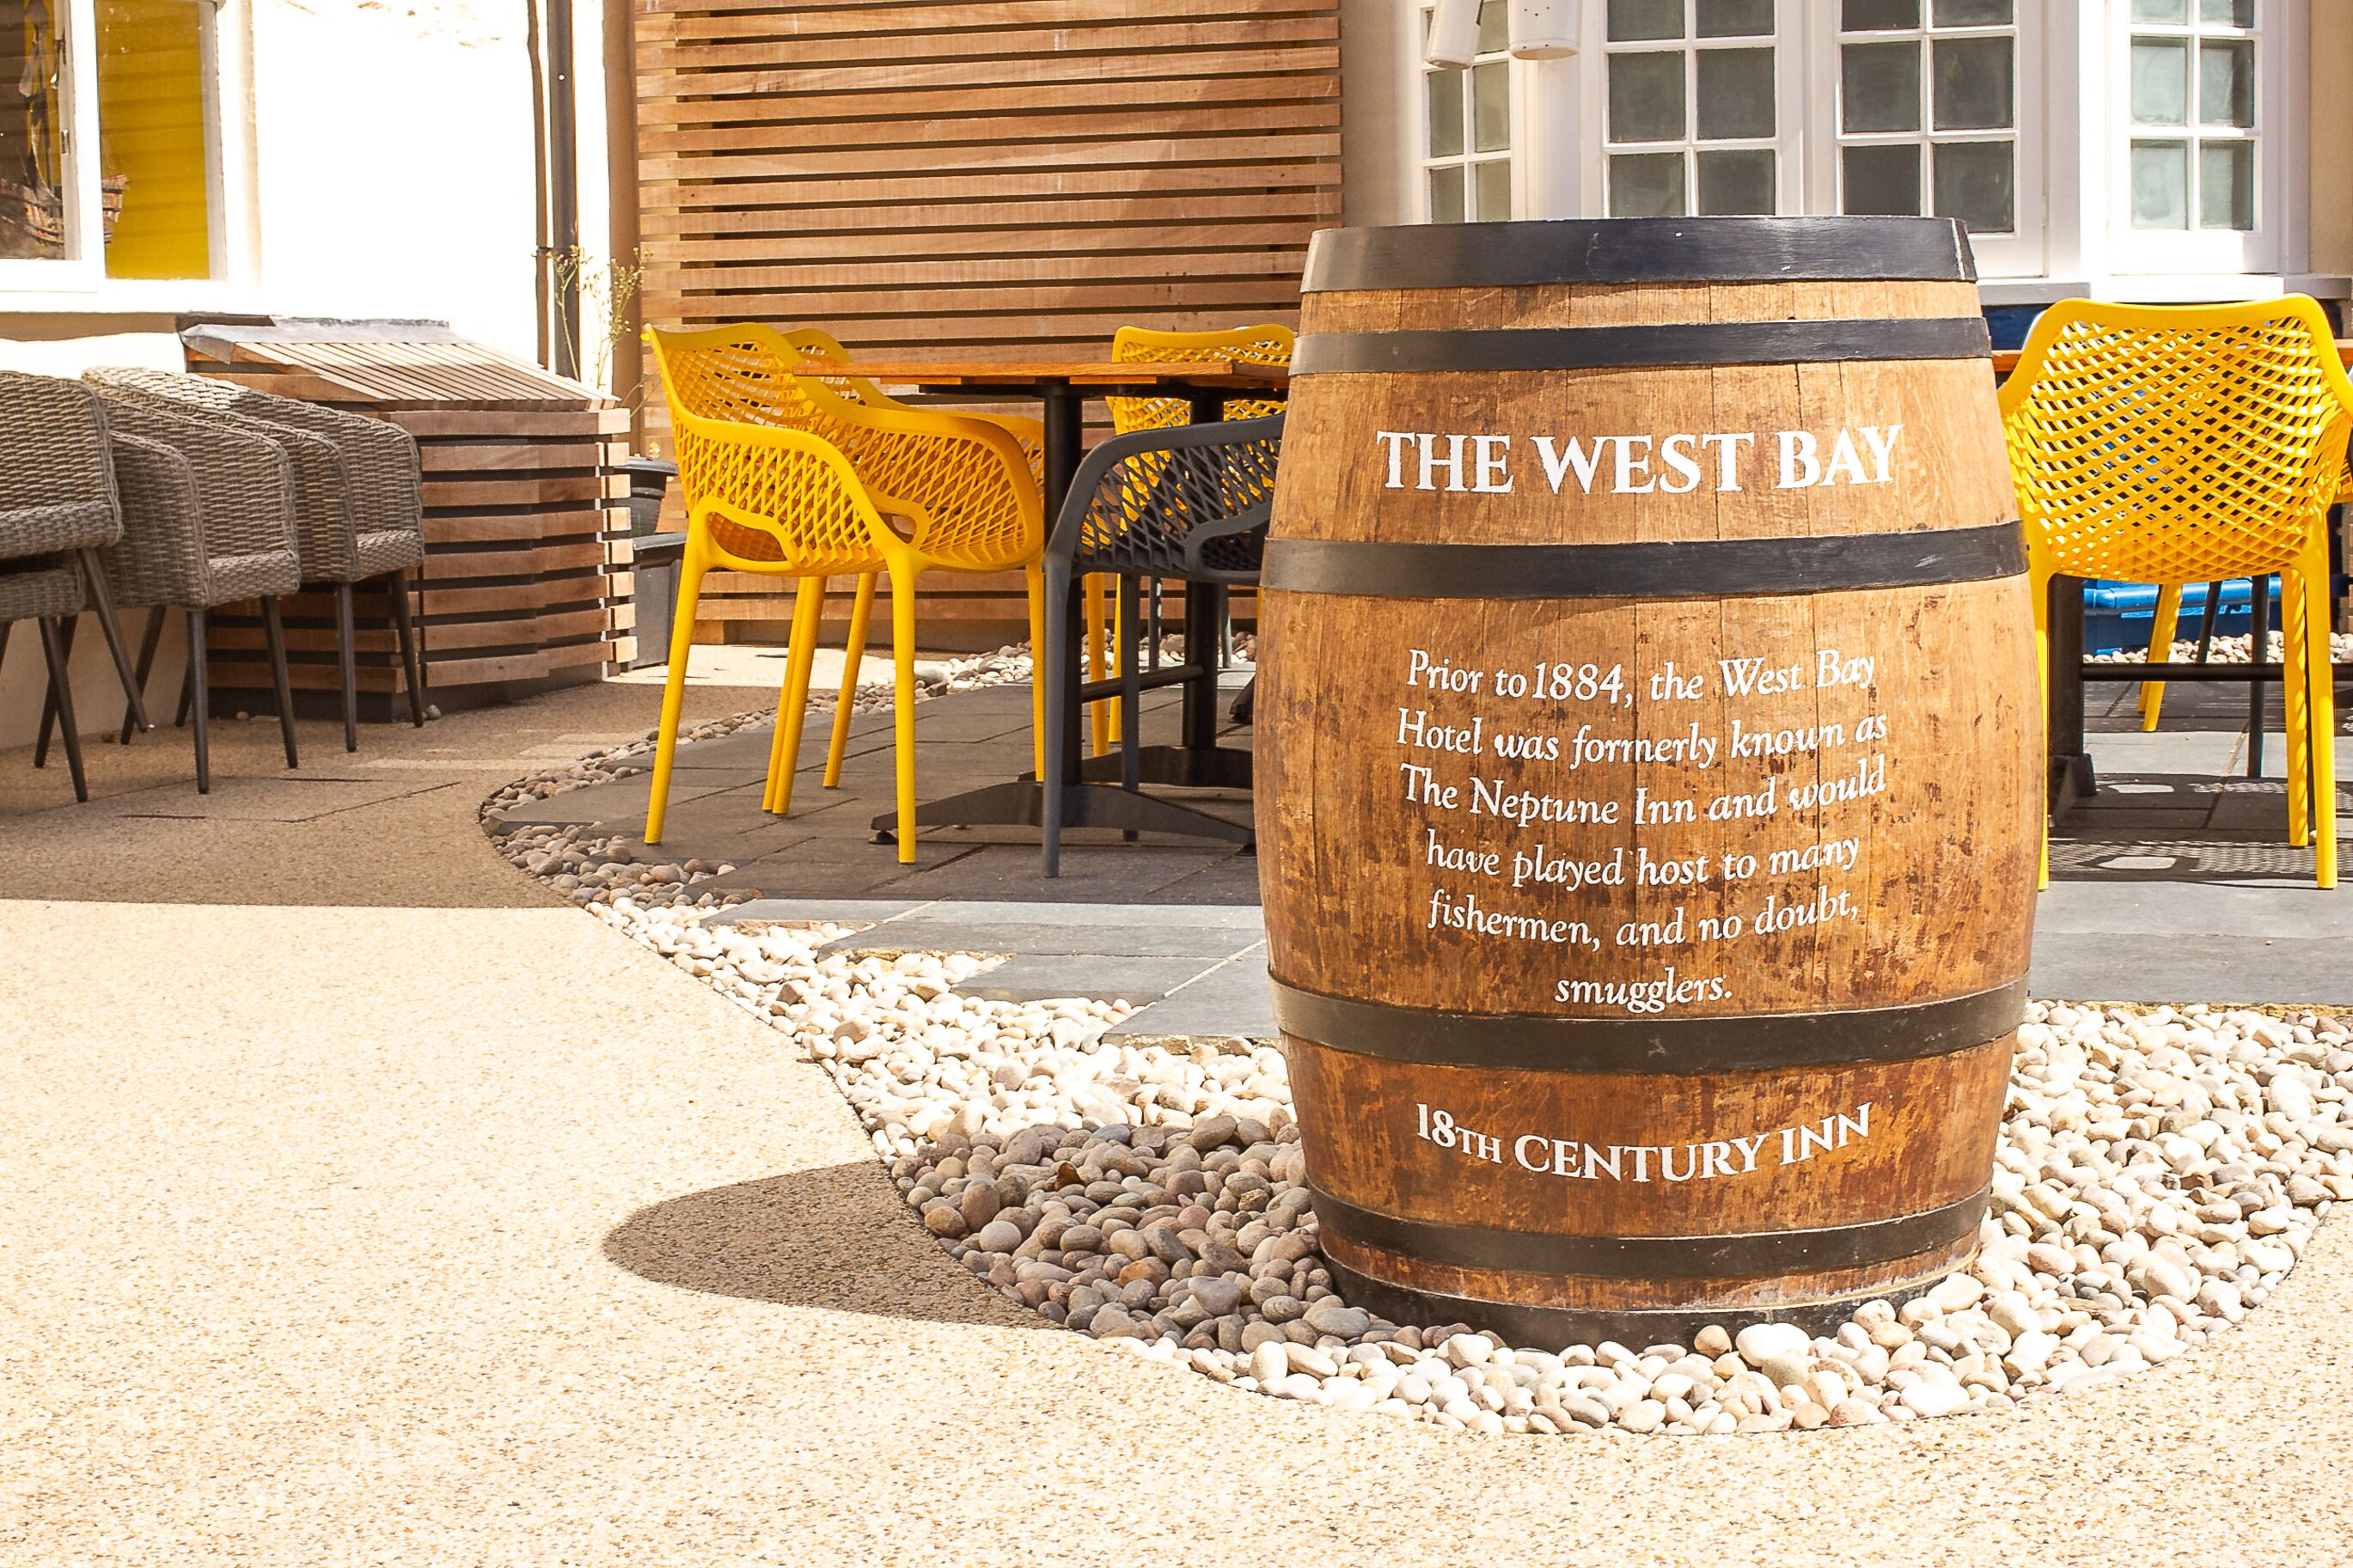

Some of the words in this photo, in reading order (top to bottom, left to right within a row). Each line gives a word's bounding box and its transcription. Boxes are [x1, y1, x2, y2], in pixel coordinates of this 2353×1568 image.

[1377, 430, 1514, 493] THE
[1530, 432, 1754, 494] WEST
[1775, 424, 1904, 490] BAY
[1407, 649, 1482, 694] Prior
[1495, 668, 1527, 698] to
[1531, 662, 1634, 709] 1884,
[1649, 661, 1704, 701] the
[1719, 656, 1803, 701] West
[1816, 649, 1875, 691] Bay
[1397, 707, 1482, 755] Hotel
[1494, 731, 1559, 762] was
[1569, 723, 1717, 771] formerly
[1730, 719, 1846, 755] known
[1855, 714, 1888, 741] as
[1399, 763, 1458, 809] The
[1469, 776, 1619, 827] Neptune
[1634, 787, 1695, 825] Inn
[1708, 777, 1777, 822] and
[1788, 754, 1886, 811] would
[1427, 829, 1501, 876] have
[1513, 845, 1626, 892] played
[1637, 847, 1709, 887] host
[1723, 850, 1757, 881] to
[1769, 835, 1861, 876] many
[1427, 889, 1600, 951] fishermen,
[1616, 906, 1686, 946] and
[1698, 915, 1741, 943] no
[1753, 886, 1859, 934] doubt,
[1555, 967, 1733, 1014] smugglers.
[1415, 1102, 1502, 1164] 18TH
[1514, 1132, 1770, 1182] CENTURY
[1779, 1101, 1873, 1166] INN
